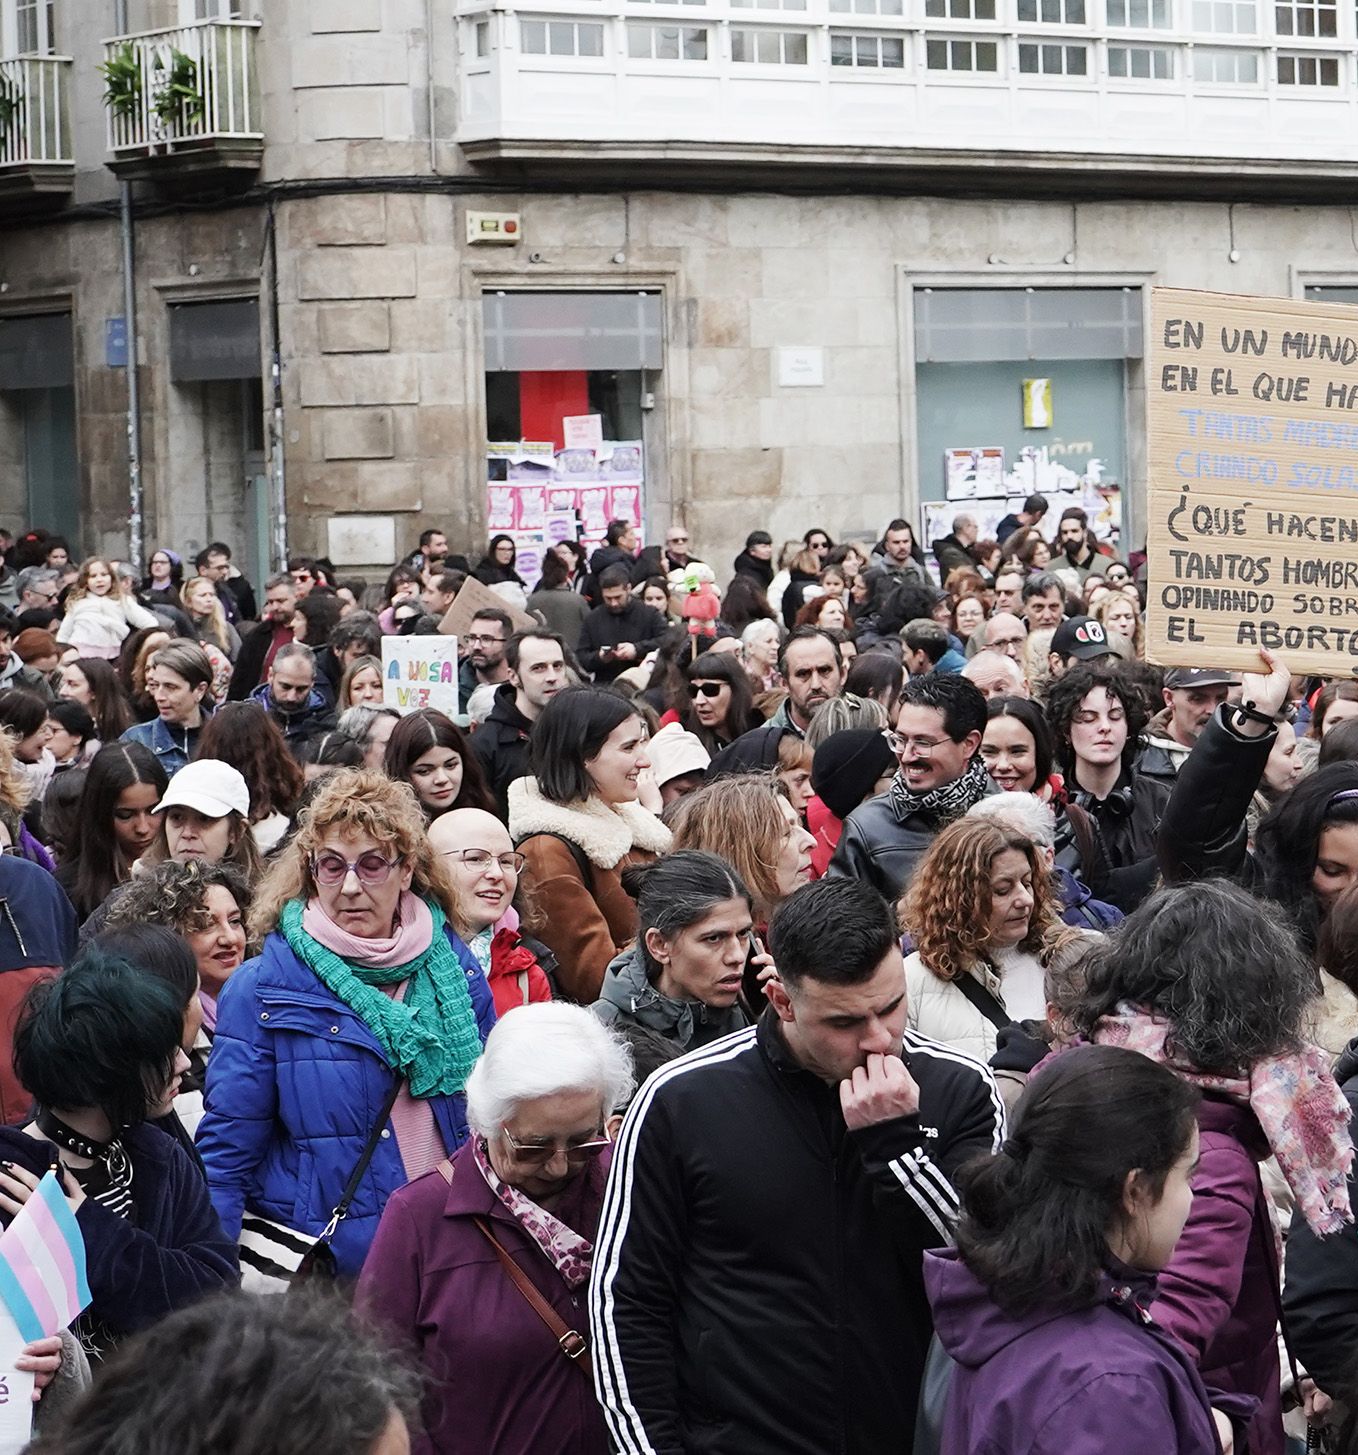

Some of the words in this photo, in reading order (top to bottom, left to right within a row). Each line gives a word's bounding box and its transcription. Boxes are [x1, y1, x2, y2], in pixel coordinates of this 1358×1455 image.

[1164, 319, 1204, 350] EN
[1221, 327, 1268, 356] UN
[1161, 365, 1198, 392] EN
[1211, 368, 1239, 395] EL
[1253, 372, 1310, 402] QUE
[1178, 409, 1274, 443] TANTAS
[1175, 450, 1278, 485] CRIANDO
[1168, 484, 1253, 542] ¿QUÉ
[1267, 512, 1358, 543] HACEN
[1169, 550, 1271, 586] TANTOS
[1161, 585, 1274, 614] OPINANDO
[1167, 616, 1205, 643] EL
[388, 659, 400, 680] A
